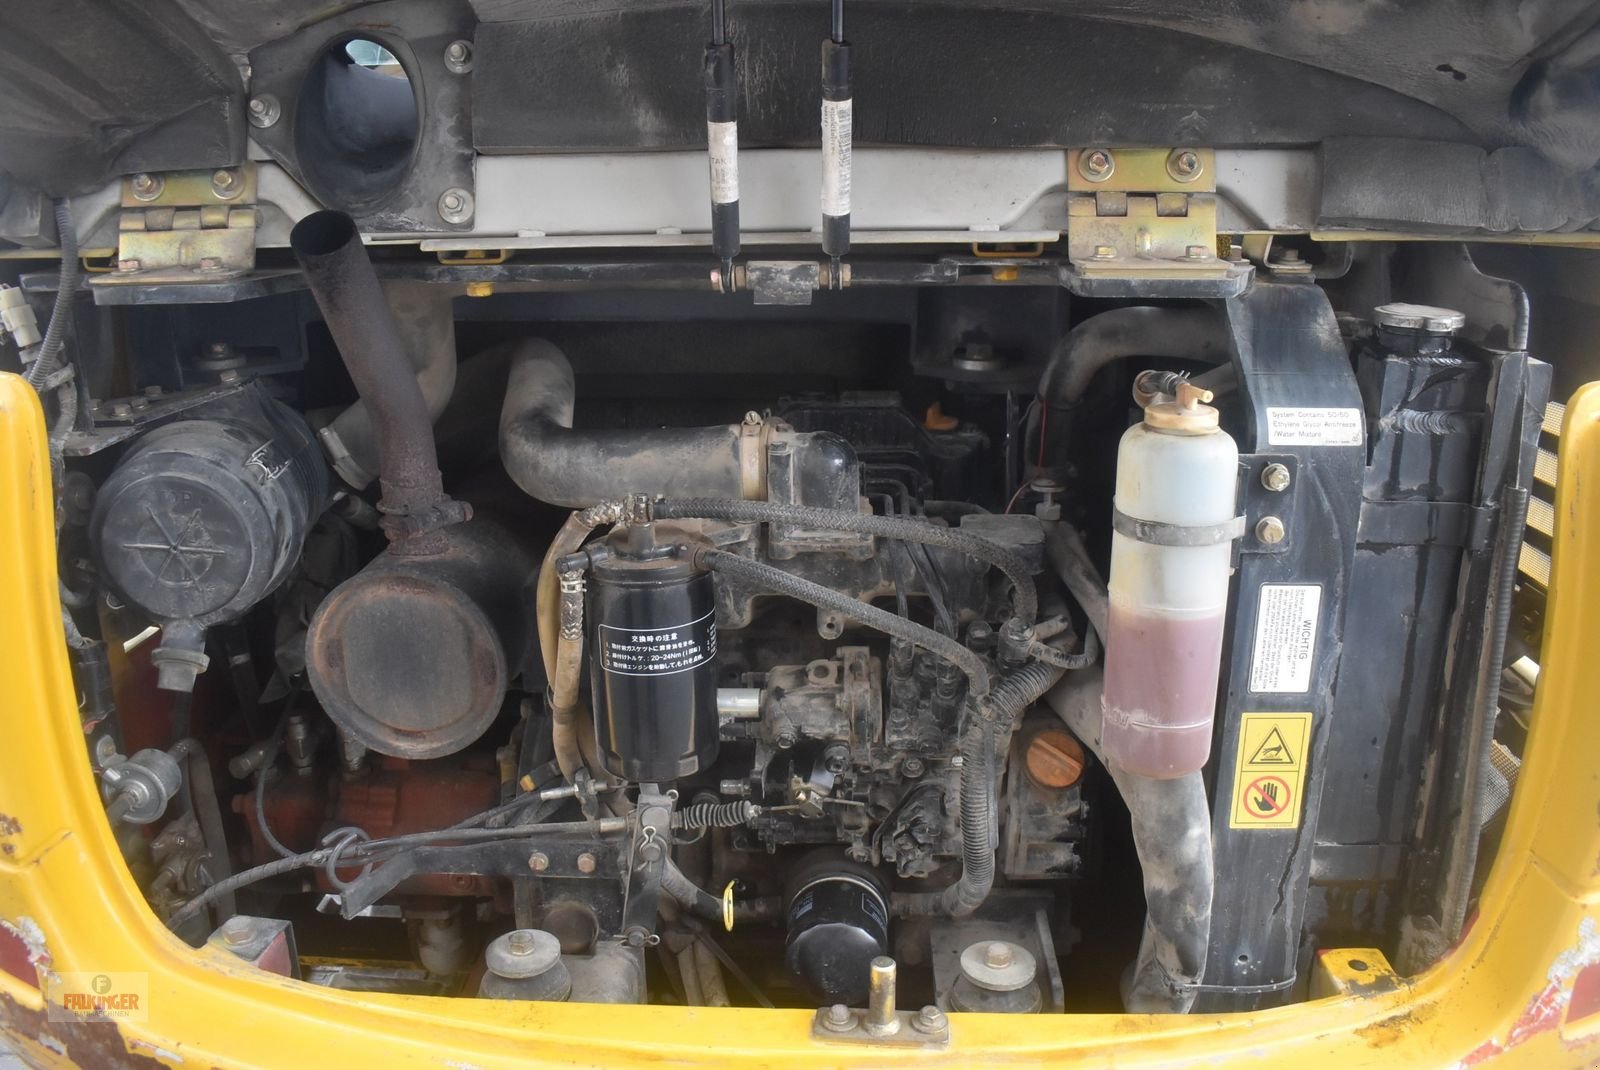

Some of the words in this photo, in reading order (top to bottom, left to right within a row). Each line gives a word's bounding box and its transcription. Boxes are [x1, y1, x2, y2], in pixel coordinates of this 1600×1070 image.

[1272, 411, 1295, 419] System
[631, 632, 678, 643] 交換時の注意
[1298, 619, 1312, 660] WICHTIG
